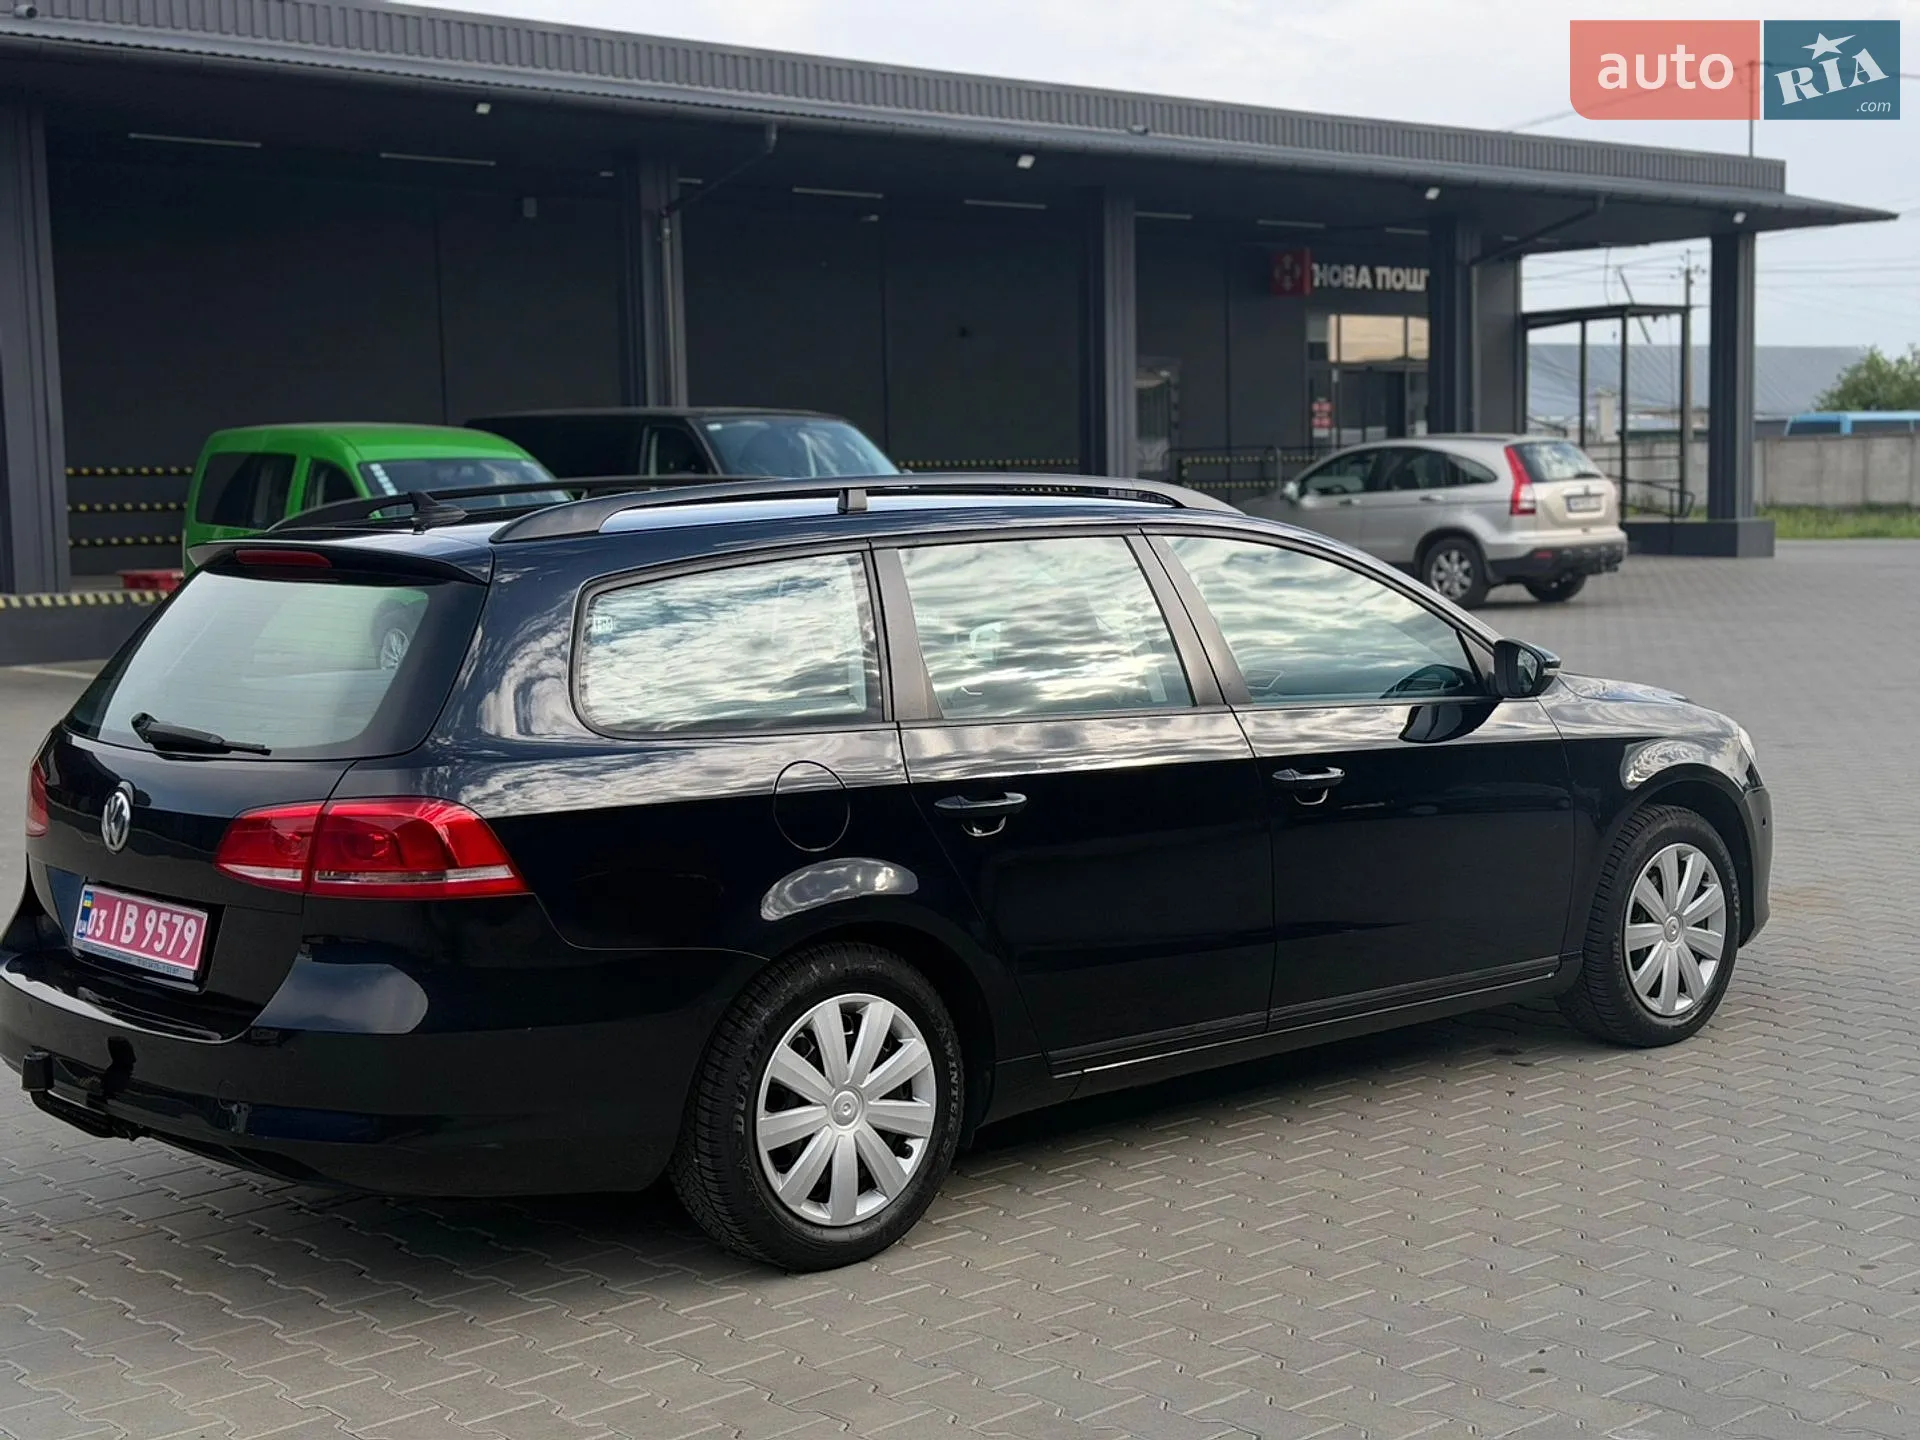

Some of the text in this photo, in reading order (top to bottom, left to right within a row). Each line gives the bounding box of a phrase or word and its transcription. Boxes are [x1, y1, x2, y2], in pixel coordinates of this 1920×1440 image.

[1312, 263, 1430, 292] НОВА ПОШ
[87, 907, 108, 938] 03
[140, 909, 197, 959] 9579
